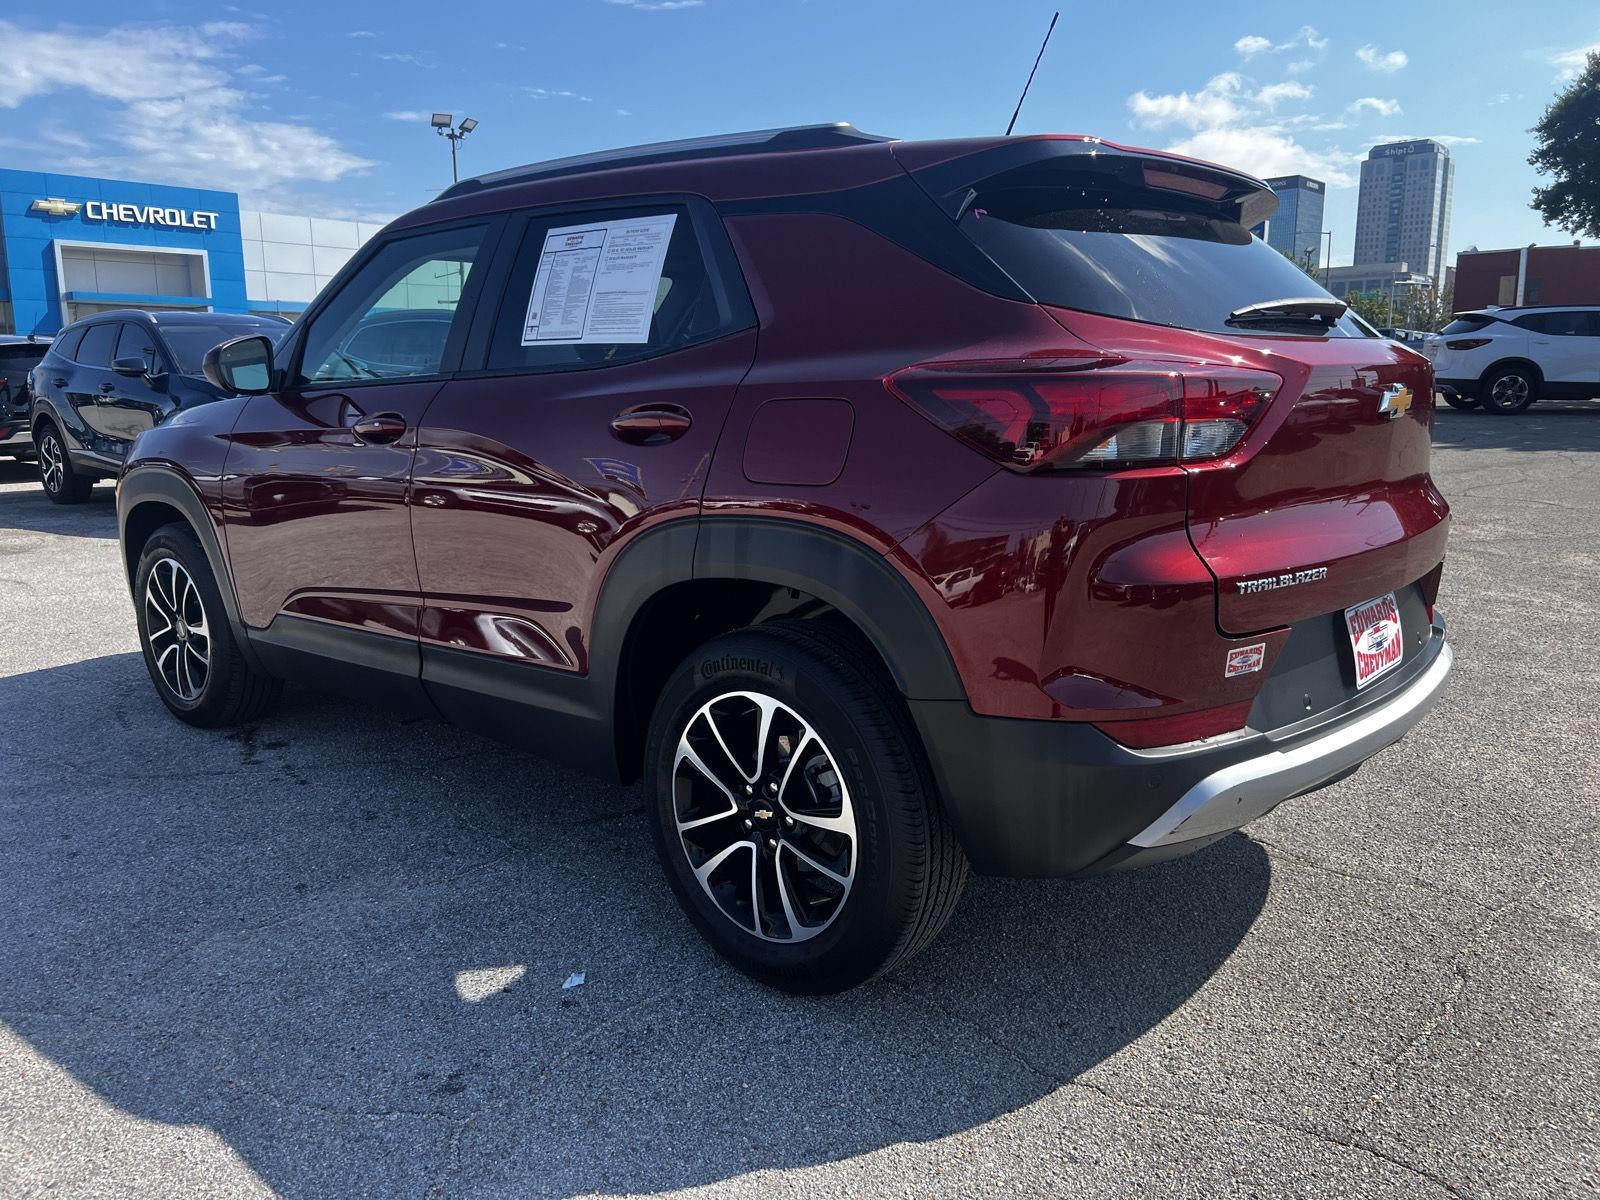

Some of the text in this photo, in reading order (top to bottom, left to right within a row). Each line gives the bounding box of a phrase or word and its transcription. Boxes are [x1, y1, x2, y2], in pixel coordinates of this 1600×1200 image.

[86, 201, 219, 230] CHEVROLET
[1236, 567, 1328, 595] TRAILBLAZER
[1349, 600, 1398, 646] EDWARDS
[701, 655, 775, 679] Continental
[1229, 646, 1263, 662] EDWARDS
[1357, 630, 1401, 680] CHEVYMAN
